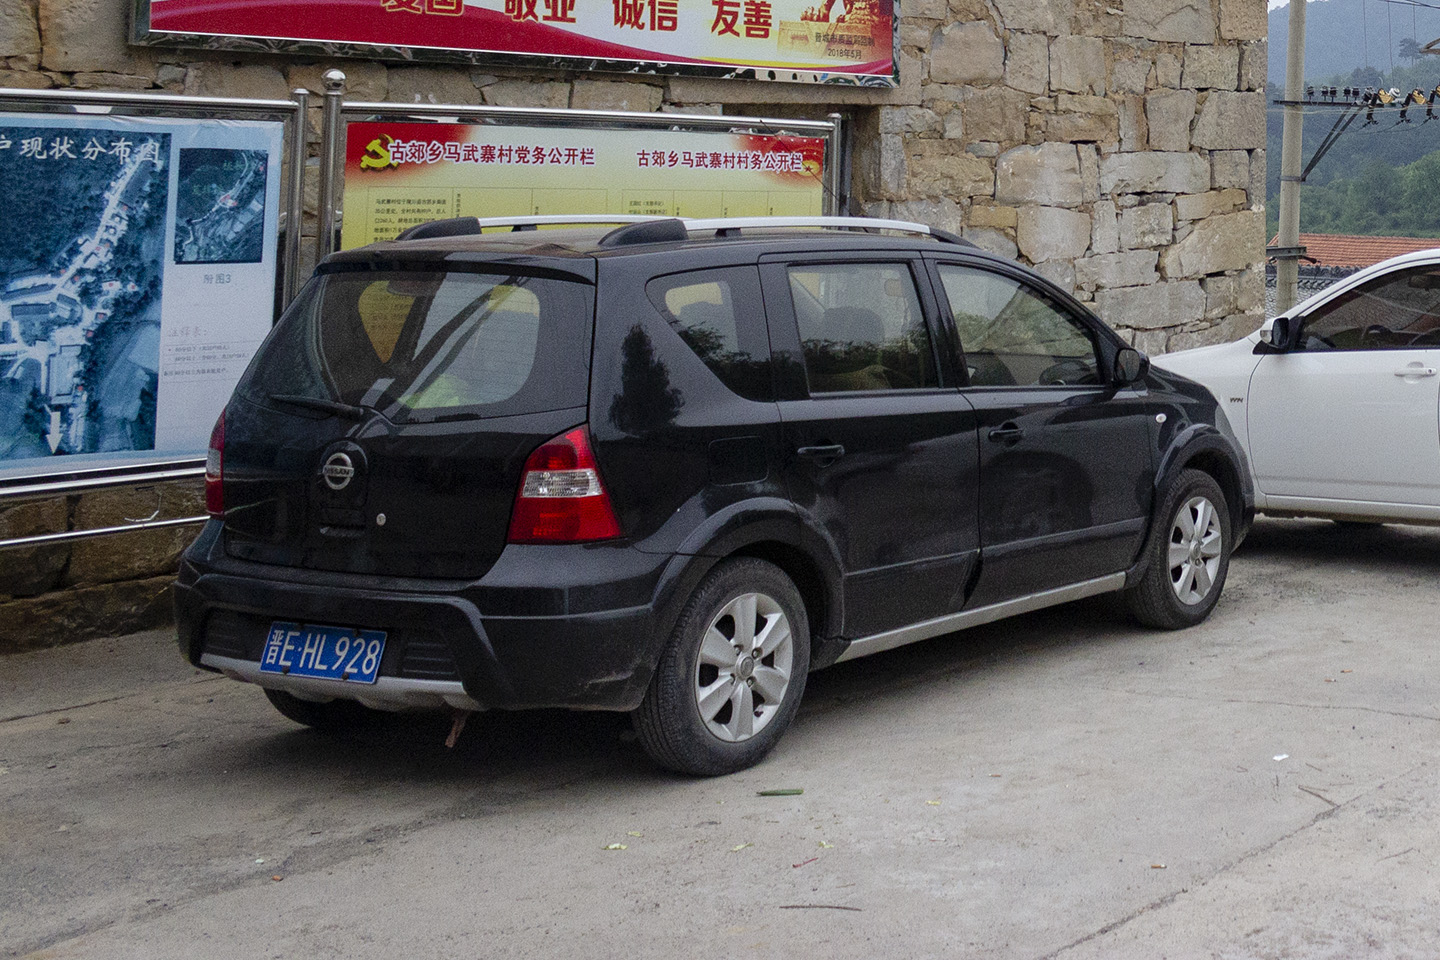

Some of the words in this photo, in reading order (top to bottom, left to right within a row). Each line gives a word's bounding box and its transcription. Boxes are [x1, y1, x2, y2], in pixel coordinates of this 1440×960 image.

[388, 140, 596, 166] 古郊乡马武寨村党务公开栏
[636, 149, 803, 171] 古郊乡马武寨村村务公开栏
[265, 629, 381, 676] 晋E·HL928
